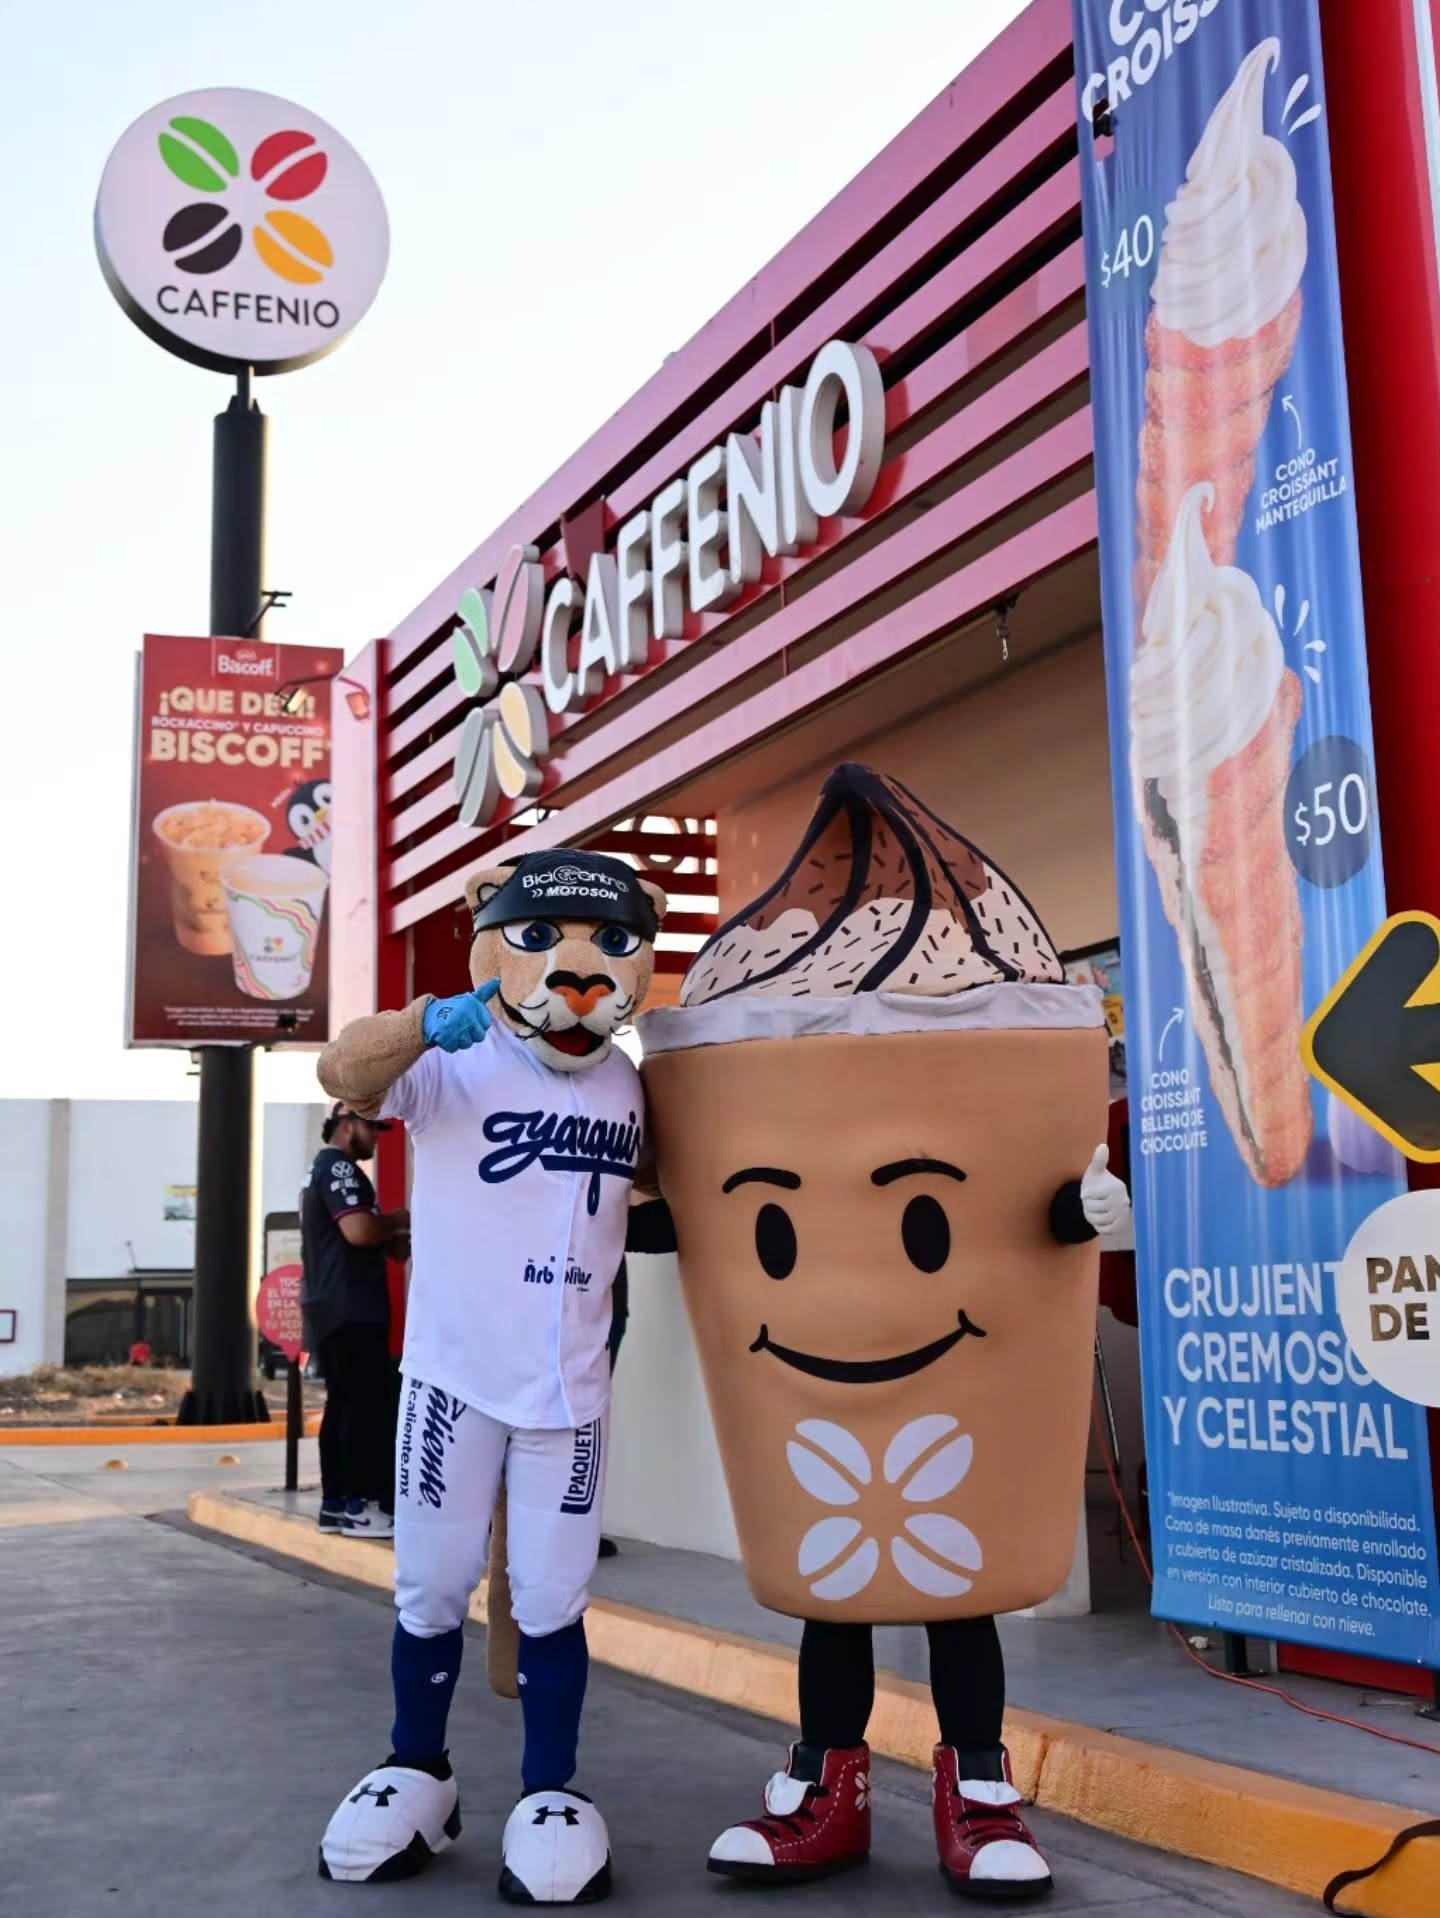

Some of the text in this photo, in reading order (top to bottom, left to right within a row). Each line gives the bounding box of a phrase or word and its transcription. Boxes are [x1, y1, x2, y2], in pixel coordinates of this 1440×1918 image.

[1100, 215, 1155, 288] $40
[156, 285, 340, 328] CAFFENIO
[1261, 457, 1339, 509] CROISSANT
[1275, 447, 1316, 481] CONO
[541, 339, 886, 714] CAFFENIO
[1255, 475, 1347, 535] MANTEQUILLA
[217, 655, 274, 676] Biscoff
[159, 686, 235, 715] ¡QUE
[1294, 773, 1369, 846] $50
[546, 886, 618, 901] MOTOSON
[1151, 1068, 1189, 1089] CONO
[1369, 1303, 1430, 1342] DE
[1162, 1396, 1409, 1460] Y CELESTIAL
[1165, 1515, 1427, 1560] Cono de masa danés previamente enrollado
[1273, 1501, 1310, 1523] Sujeto
[1313, 1509, 1321, 1521] a
[1324, 1506, 1421, 1532] disponibilidad.
[1175, 1541, 1220, 1561] cubierto
[1222, 1546, 1237, 1563] de
[1239, 1550, 1278, 1569] azúcar
[1280, 1554, 1354, 1580] cristalizada.
[1356, 1562, 1428, 1589] Disponible
[1182, 1567, 1220, 1585] versión
[1222, 1574, 1242, 1589] con
[1244, 1573, 1286, 1595] interior
[1288, 1581, 1339, 1604] cubierto
[1341, 1588, 1359, 1606] de
[1361, 1591, 1432, 1617] chocolate.
[1208, 1593, 1376, 1637] Listo para rellenar con nieve.
